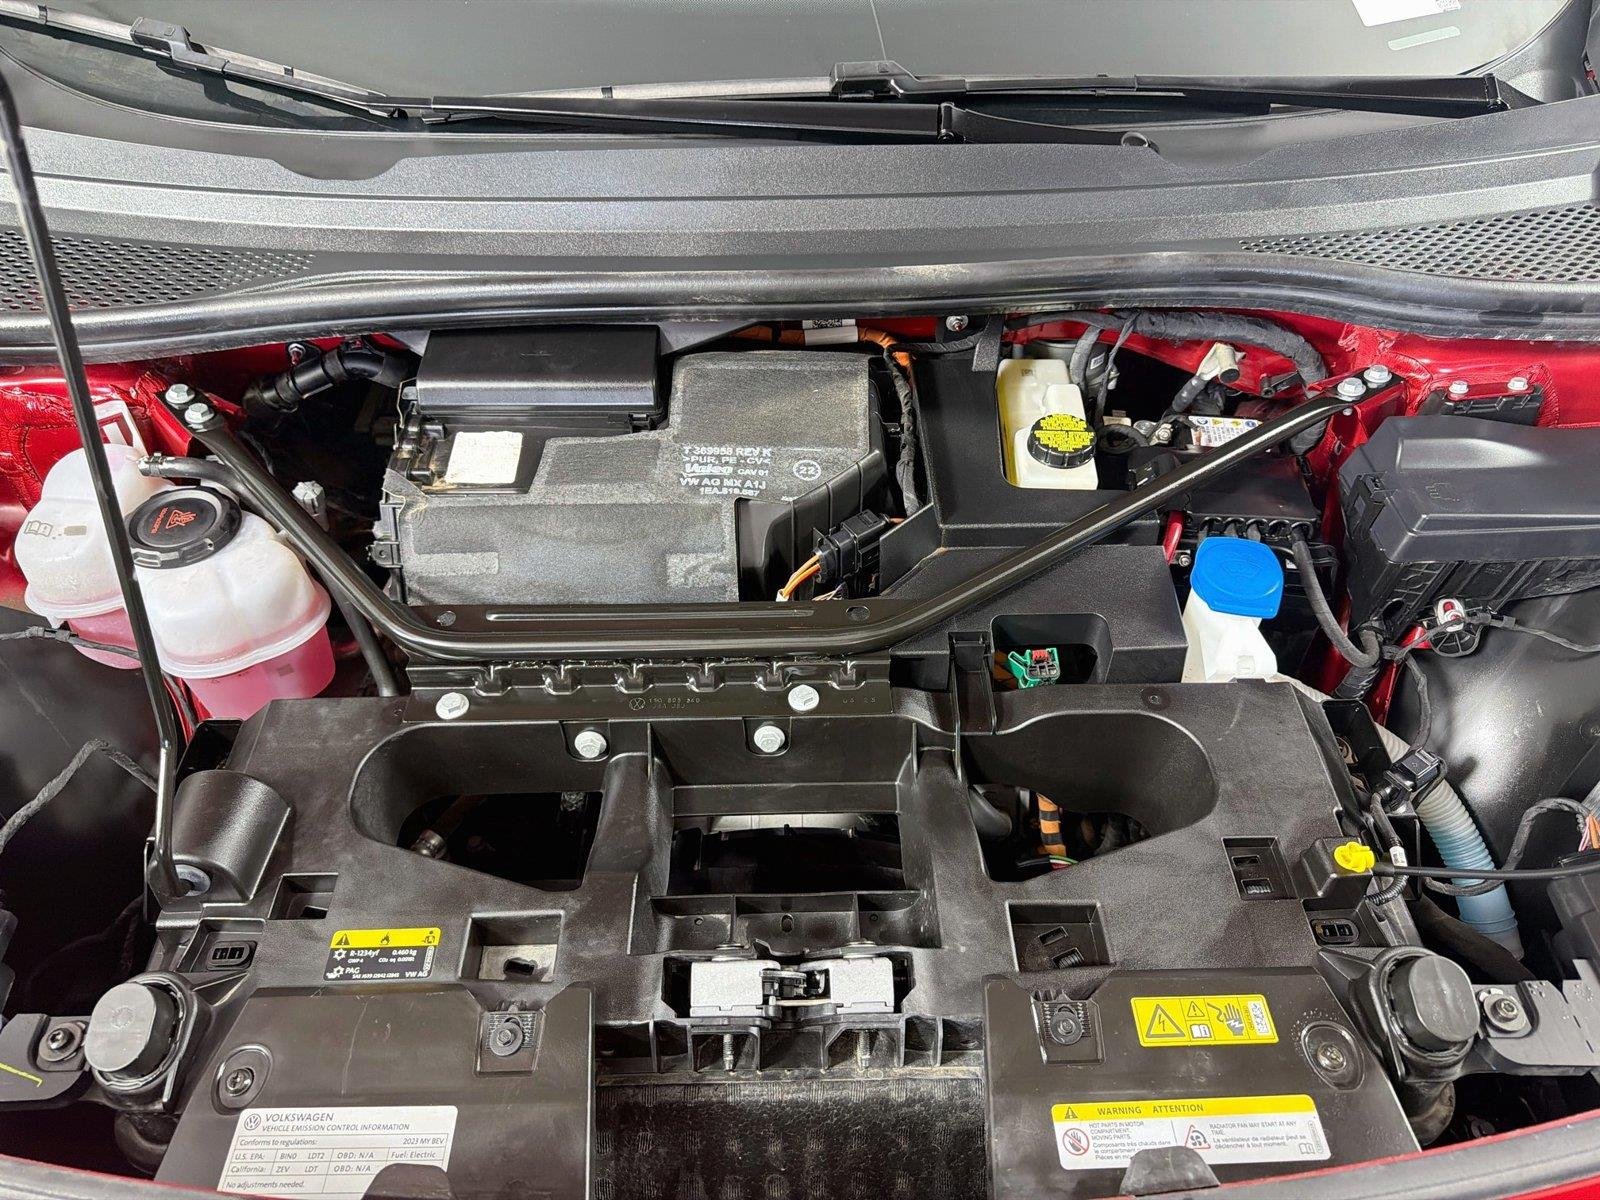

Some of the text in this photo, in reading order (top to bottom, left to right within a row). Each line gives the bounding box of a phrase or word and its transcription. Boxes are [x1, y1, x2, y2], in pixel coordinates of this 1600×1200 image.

[736, 447, 760, 456] REV
[762, 448, 772, 457] K
[799, 466, 815, 474] 22
[723, 478, 742, 486] MX
[350, 950, 380, 958] R-1234yf
[1097, 1104, 1204, 1115] WARNING ATTENTION
[266, 1113, 335, 1122] VOLKSWAGEN
[280, 1139, 318, 1148] regulations:
[237, 1181, 278, 1190] adjustments
